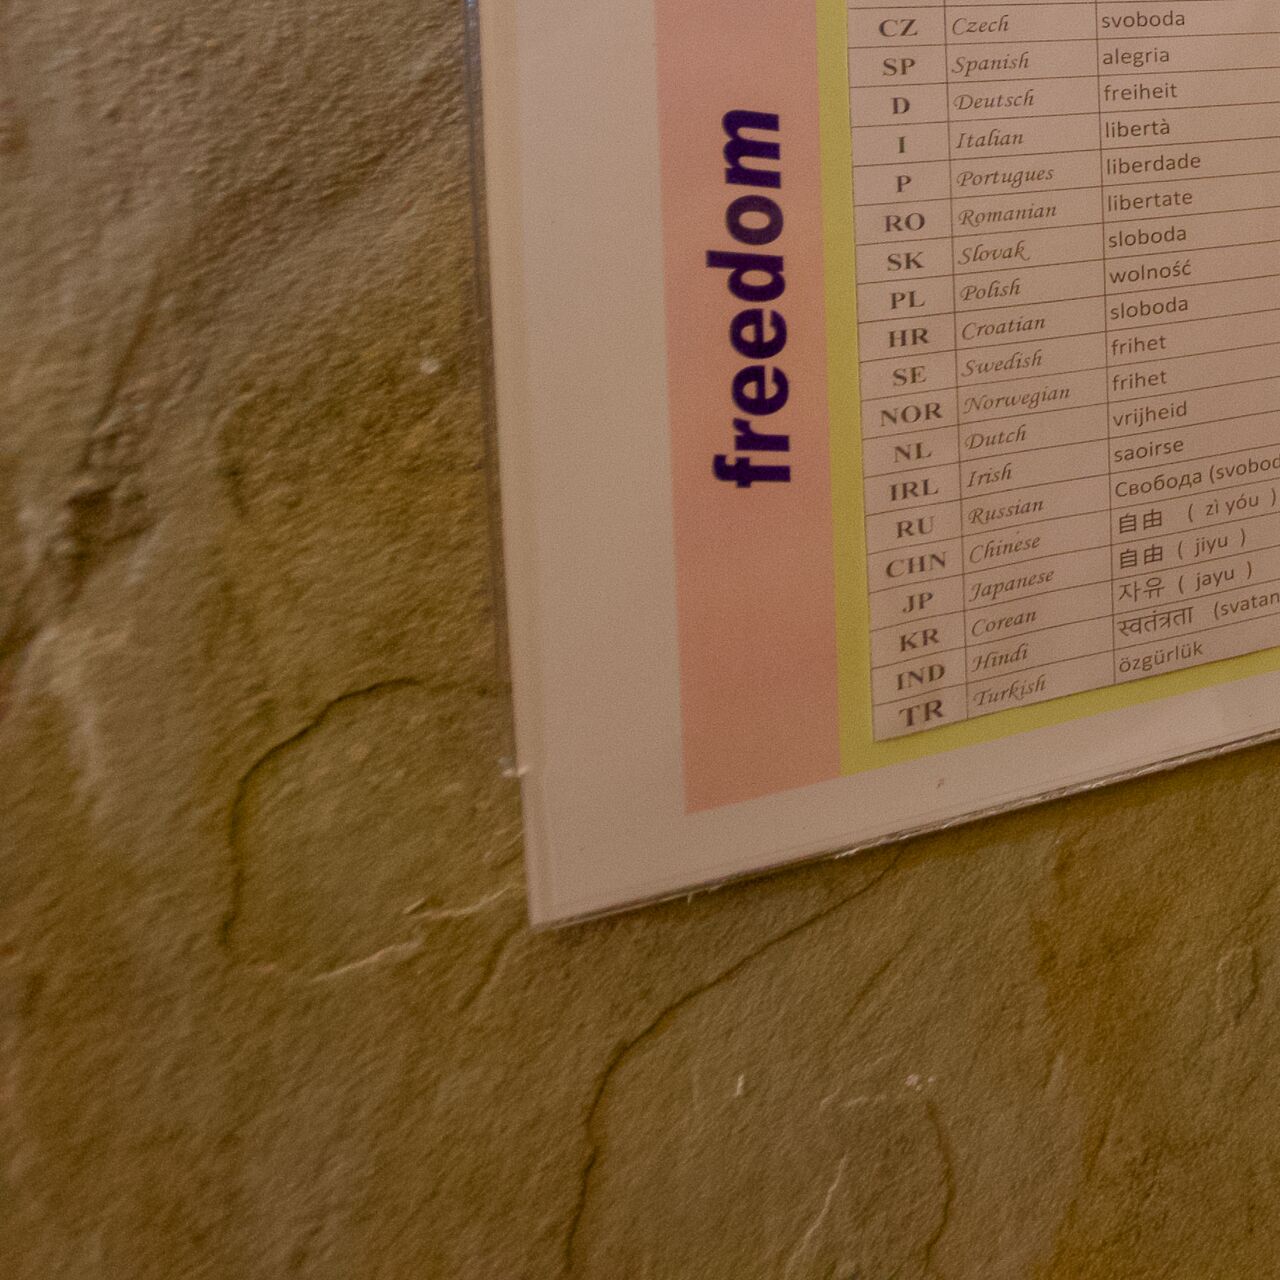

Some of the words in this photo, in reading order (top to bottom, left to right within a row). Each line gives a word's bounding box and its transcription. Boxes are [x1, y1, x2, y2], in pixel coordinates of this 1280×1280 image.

[879, 19, 918, 37] CZ
[952, 15, 1008, 35] Czech
[1101, 10, 1185, 29] svoboda
[883, 58, 916, 76] SP
[952, 52, 1029, 77] Spanish
[1102, 47, 1170, 68] alegria
[892, 97, 910, 114] D
[954, 89, 1034, 110] Deutsch
[1104, 82, 1177, 101] freiheit
[898, 136, 905, 153] I
[955, 129, 1023, 148] Italian
[1105, 118, 1170, 138] libertà
[896, 175, 912, 192] P
[956, 168, 1054, 188] Portugues
[1106, 153, 1201, 175] liberdade
[884, 213, 925, 232] RO
[959, 203, 1057, 227] Romanian
[1107, 190, 1193, 211] libertate
[887, 251, 925, 271] SK
[958, 240, 1031, 265] Slovak
[1108, 225, 1187, 248] sloboda
[705, 109, 791, 489] freedom
[890, 291, 925, 309] PL
[961, 278, 1021, 301] Polish
[1109, 259, 1191, 284] wolność
[888, 327, 929, 348] HR
[962, 317, 1045, 340] Croatian
[1110, 296, 1188, 320] sloboda
[893, 366, 927, 386] SE
[961, 349, 1042, 376] Swedish
[1111, 335, 1167, 356] frihet
[880, 402, 943, 426] NOR
[964, 387, 1070, 414] Norwegian
[1112, 370, 1168, 391] frihet
[893, 442, 932, 462] NL
[965, 424, 1026, 449] Dutch
[1112, 400, 1187, 427] vrijheid
[890, 479, 939, 501] IRL
[967, 463, 1012, 488] Irish
[1114, 439, 1184, 463] saoirse
[1114, 471, 1202, 498] Свобода
[896, 516, 936, 538] RU
[969, 499, 1043, 524] Russian
[886, 552, 947, 578] CHN
[969, 536, 1040, 564] Chinese
[902, 592, 934, 613] JP
[969, 570, 1054, 602] Japanese
[1118, 577, 1165, 602] 자유
[900, 628, 940, 651] KR
[971, 611, 1037, 636] Corean
[896, 663, 945, 690] IND
[971, 643, 1028, 672] Hindi
[899, 699, 943, 726] TR
[973, 674, 1046, 706] Turkish
[1119, 641, 1203, 673] özgürlük
